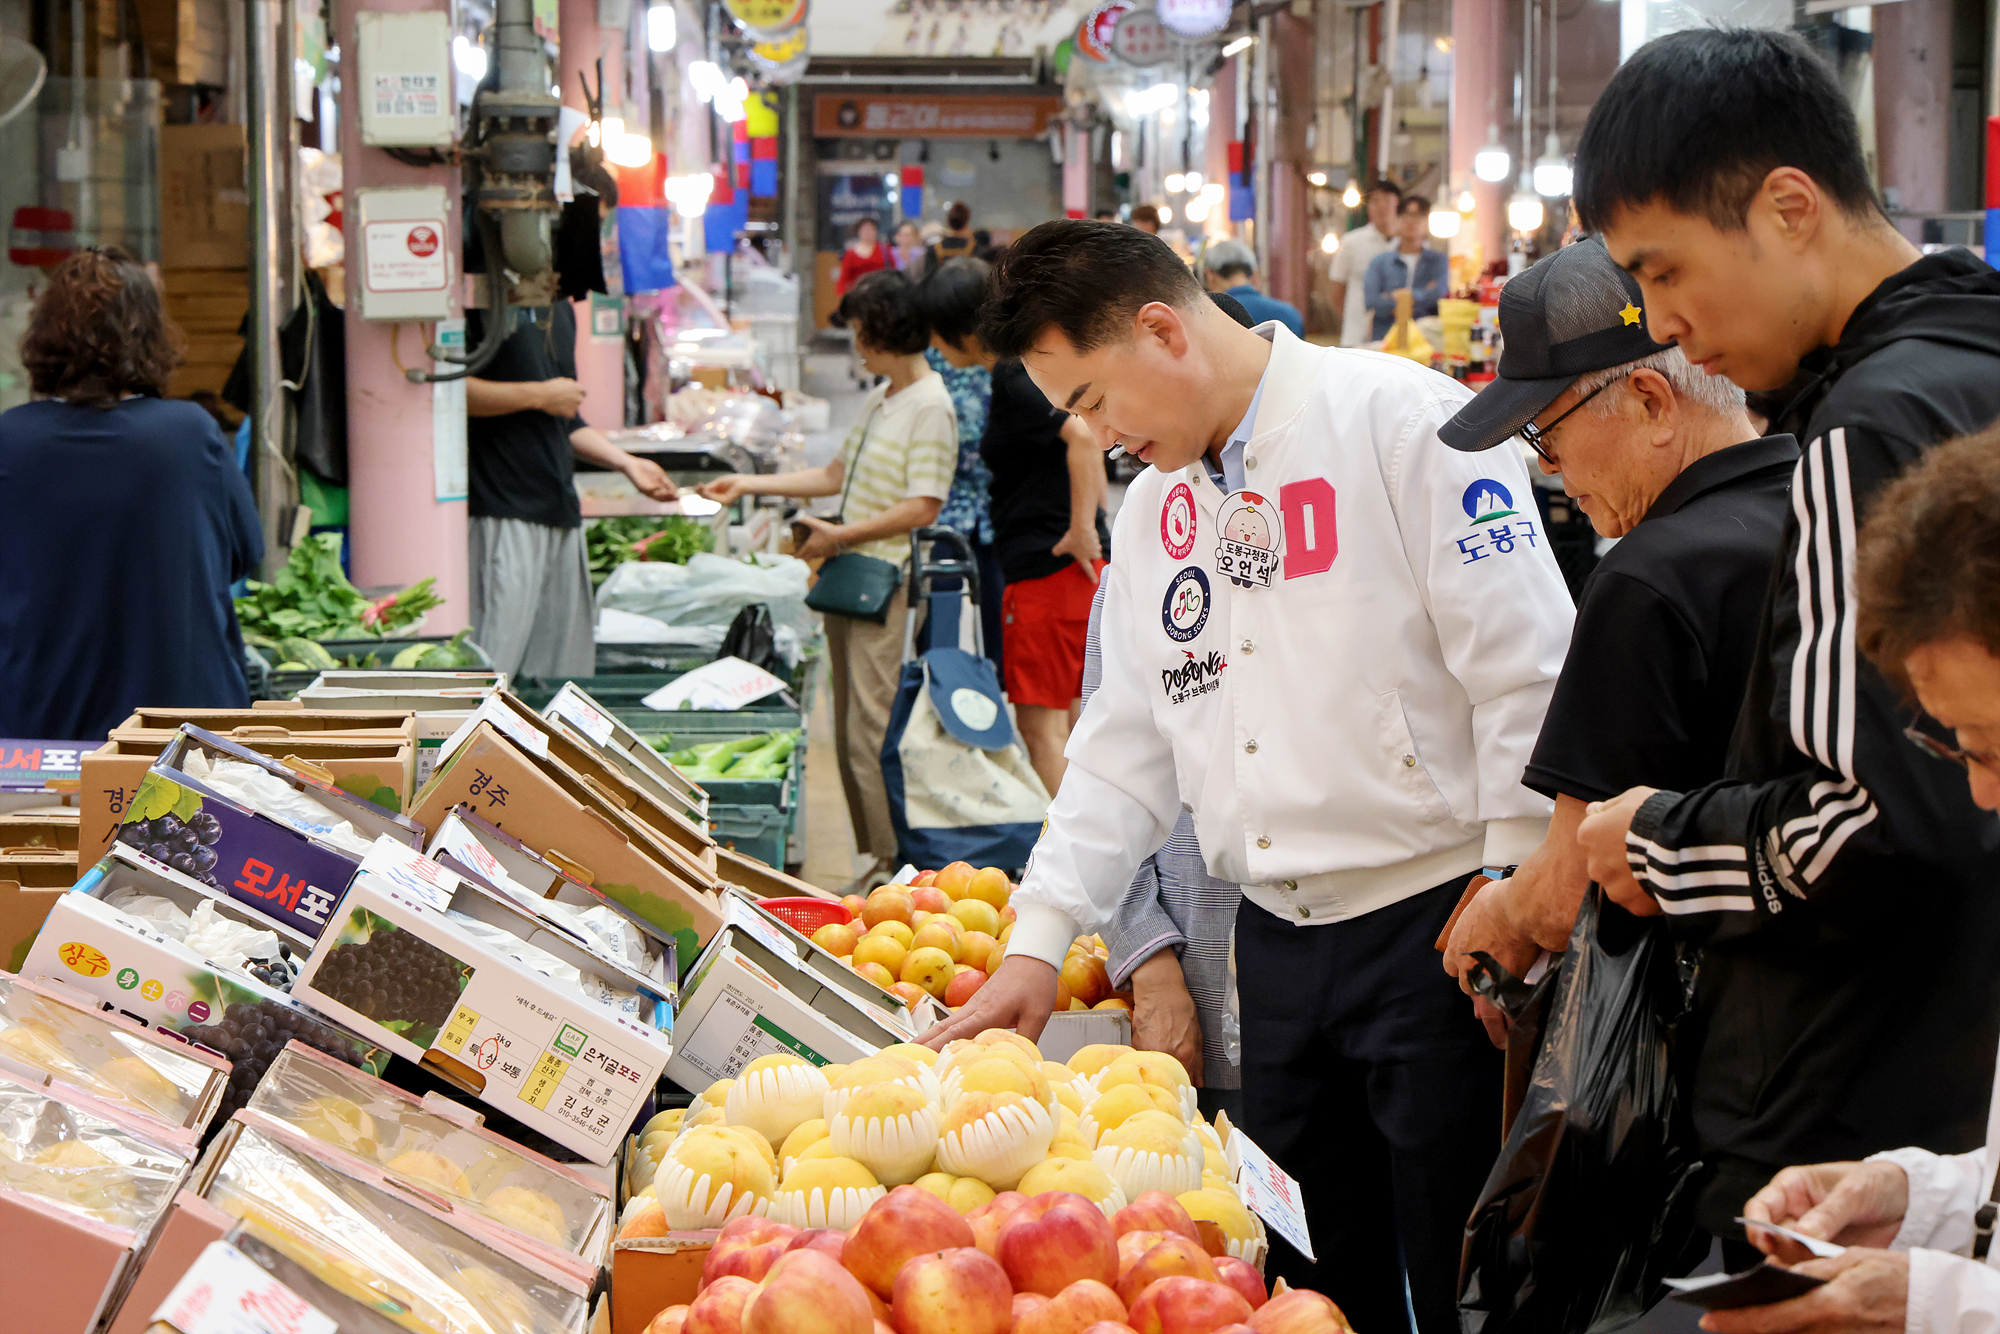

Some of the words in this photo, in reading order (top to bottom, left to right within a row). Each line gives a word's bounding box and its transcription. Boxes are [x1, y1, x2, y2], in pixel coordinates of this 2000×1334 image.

[1281, 478, 1337, 580] D
[1456, 522, 1537, 564] 도봉구
[1226, 543, 1269, 563] 도봉구청장
[1176, 570, 1195, 585] SEOUL
[1166, 623, 1192, 640] DOBONG
[1194, 607, 1209, 634] SOCKS
[1172, 690, 1190, 704] 도봉구
[0, 748, 96, 771] 서포
[470, 768, 510, 807] 경주
[62, 944, 108, 975] 상주
[495, 1033, 512, 1048] 3kg
[565, 1031, 581, 1042] GAP
[743, 1035, 757, 1048] 산지
[547, 1055, 562, 1068] 품종
[722, 1063, 738, 1077] (개수)
[541, 1065, 557, 1078] 산지
[558, 1107, 603, 1136] 010-3546-6437
